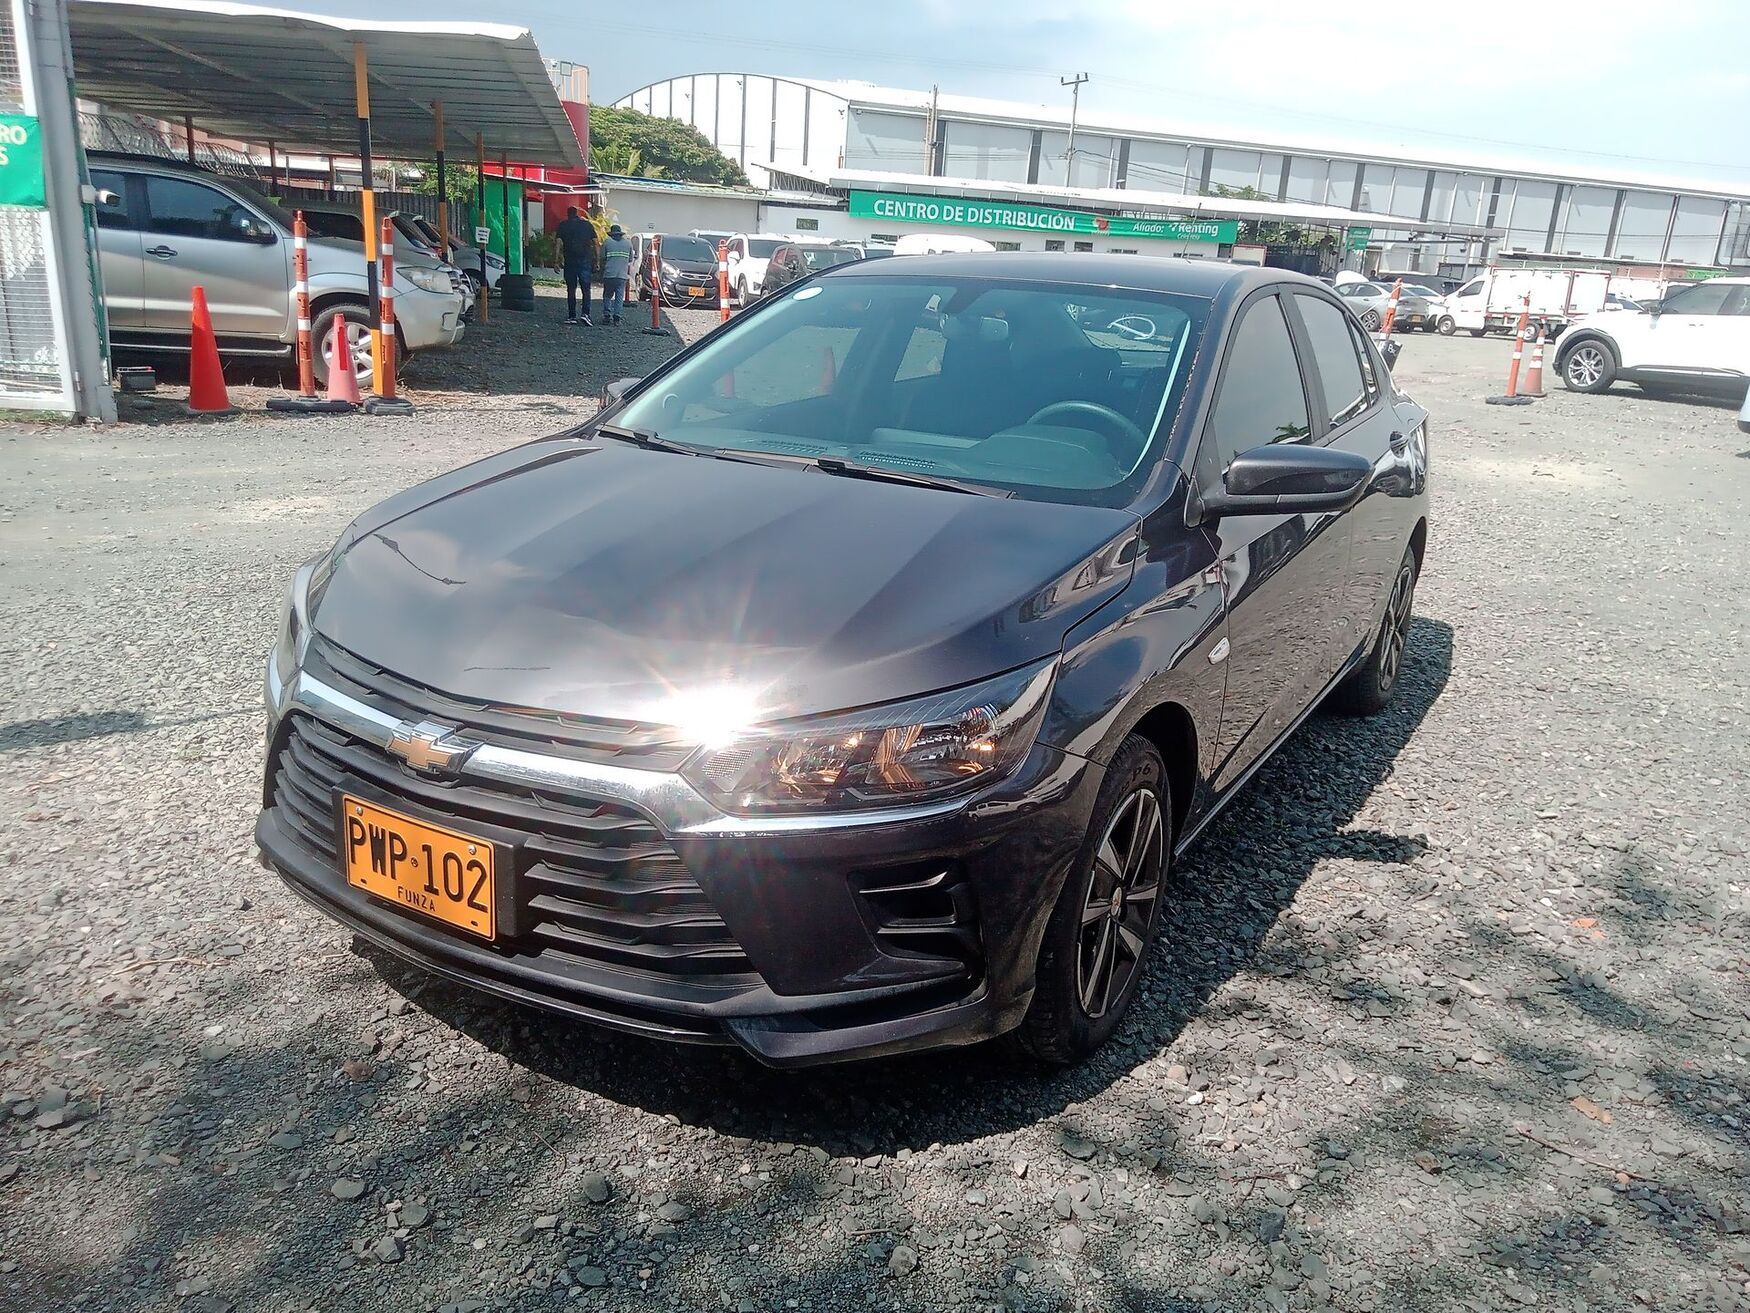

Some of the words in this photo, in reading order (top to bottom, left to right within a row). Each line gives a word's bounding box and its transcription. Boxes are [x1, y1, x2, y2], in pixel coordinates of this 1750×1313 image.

[873, 199, 940, 220] CENTRO
[942, 205, 965, 222] DE
[967, 207, 1076, 231] DISTRIBUCIÓN
[1178, 222, 1219, 237] Renting
[348, 815, 408, 881] PWP
[421, 844, 489, 914] 102
[397, 886, 436, 913] FUNZA
